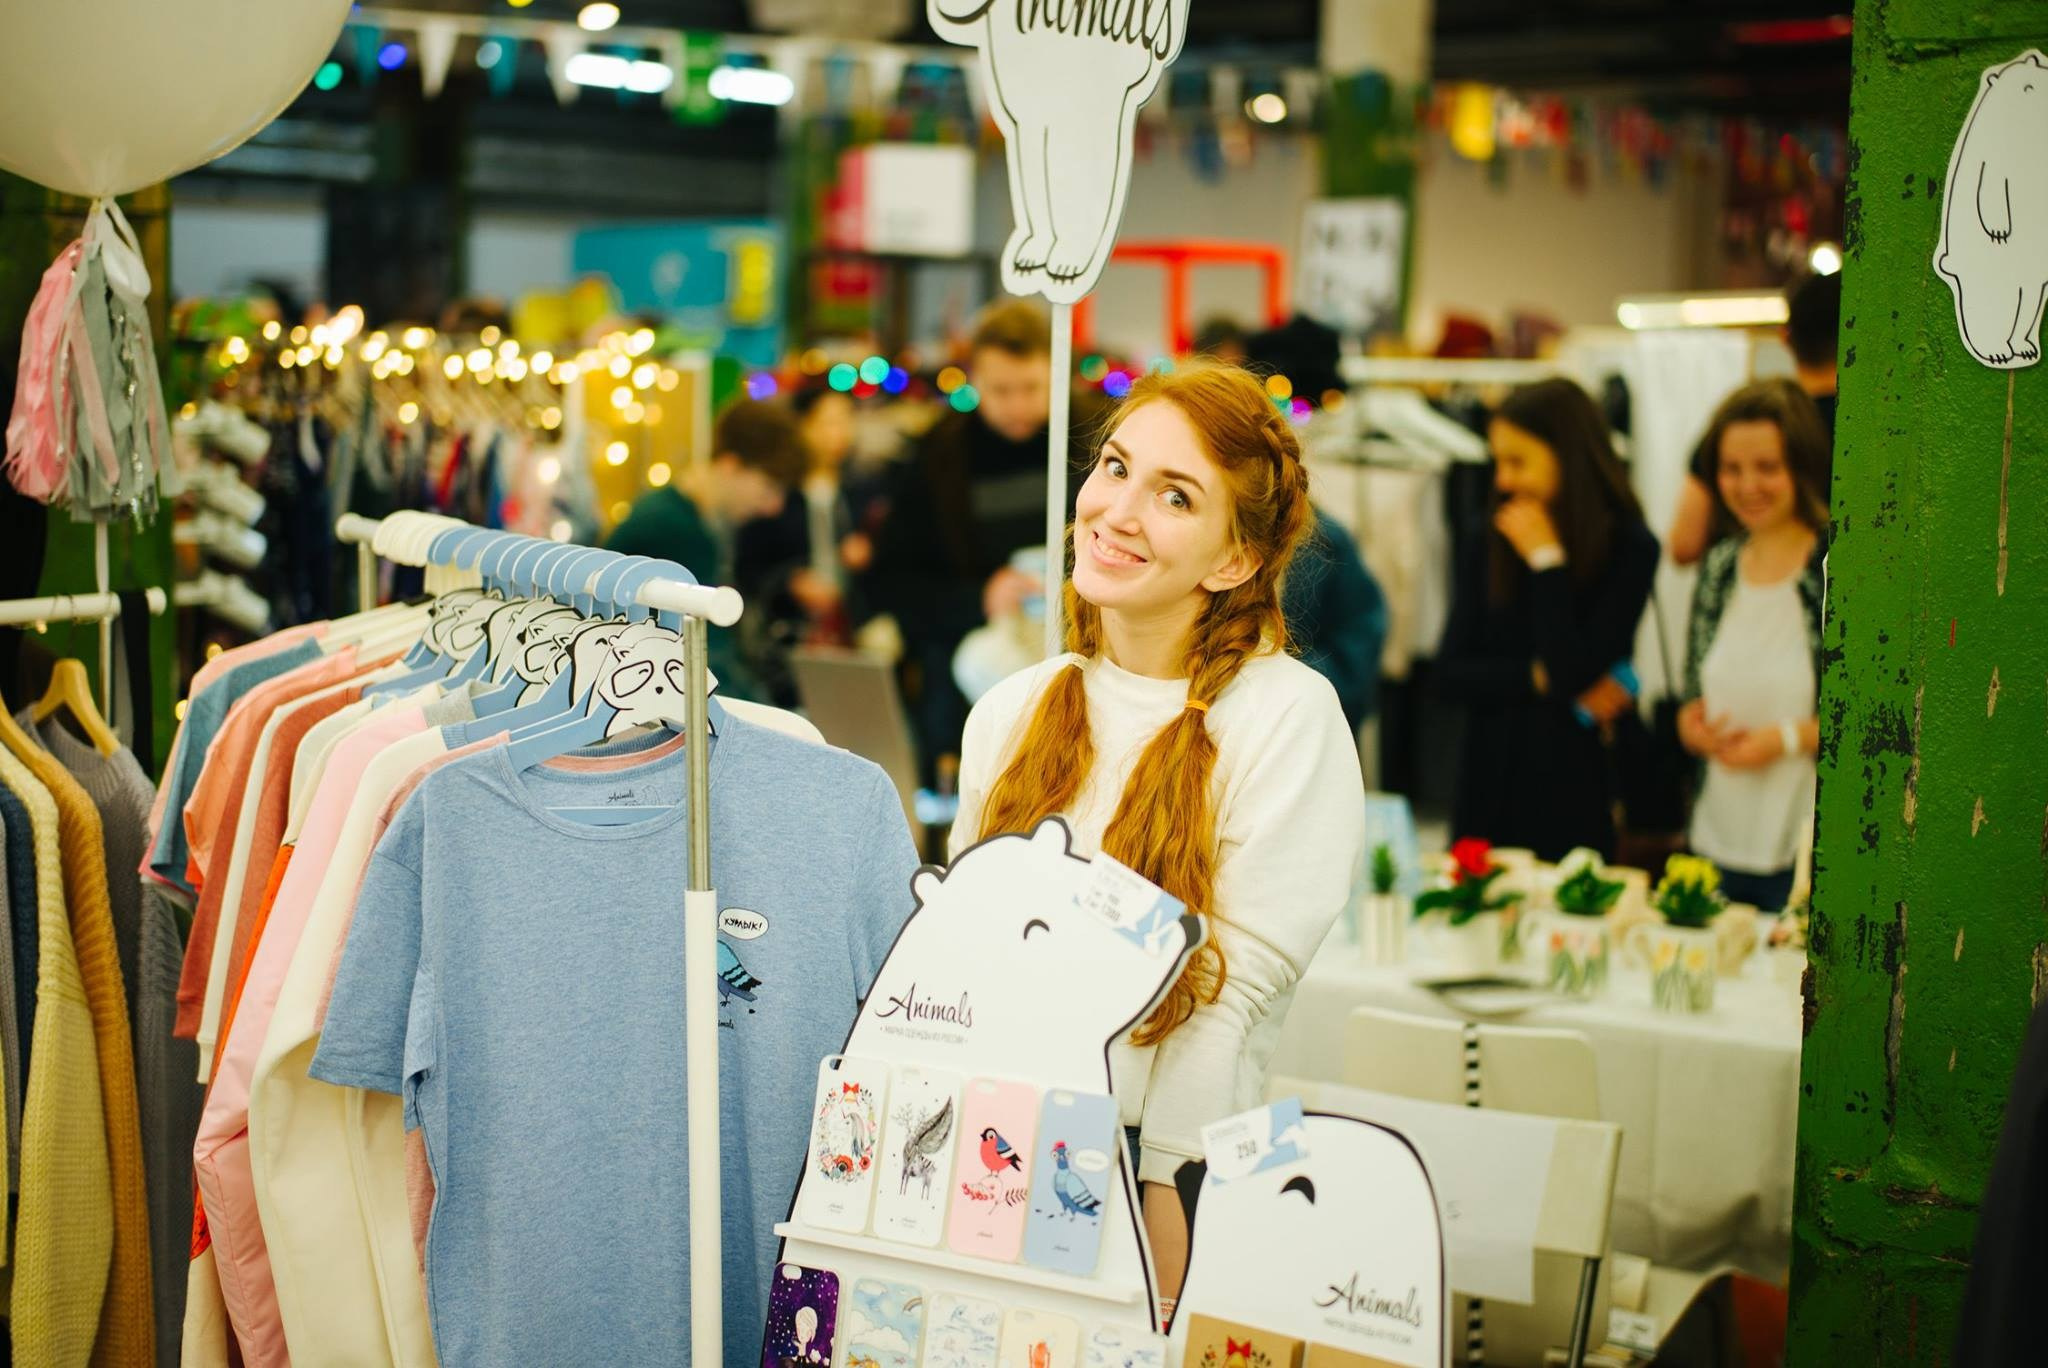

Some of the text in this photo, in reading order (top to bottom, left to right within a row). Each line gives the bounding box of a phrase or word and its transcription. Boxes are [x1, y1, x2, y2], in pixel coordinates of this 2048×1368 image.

[724, 917, 763, 932] КУРЛЫК!
[875, 982, 972, 1028] Animals
[1313, 1270, 1421, 1328] Animals
